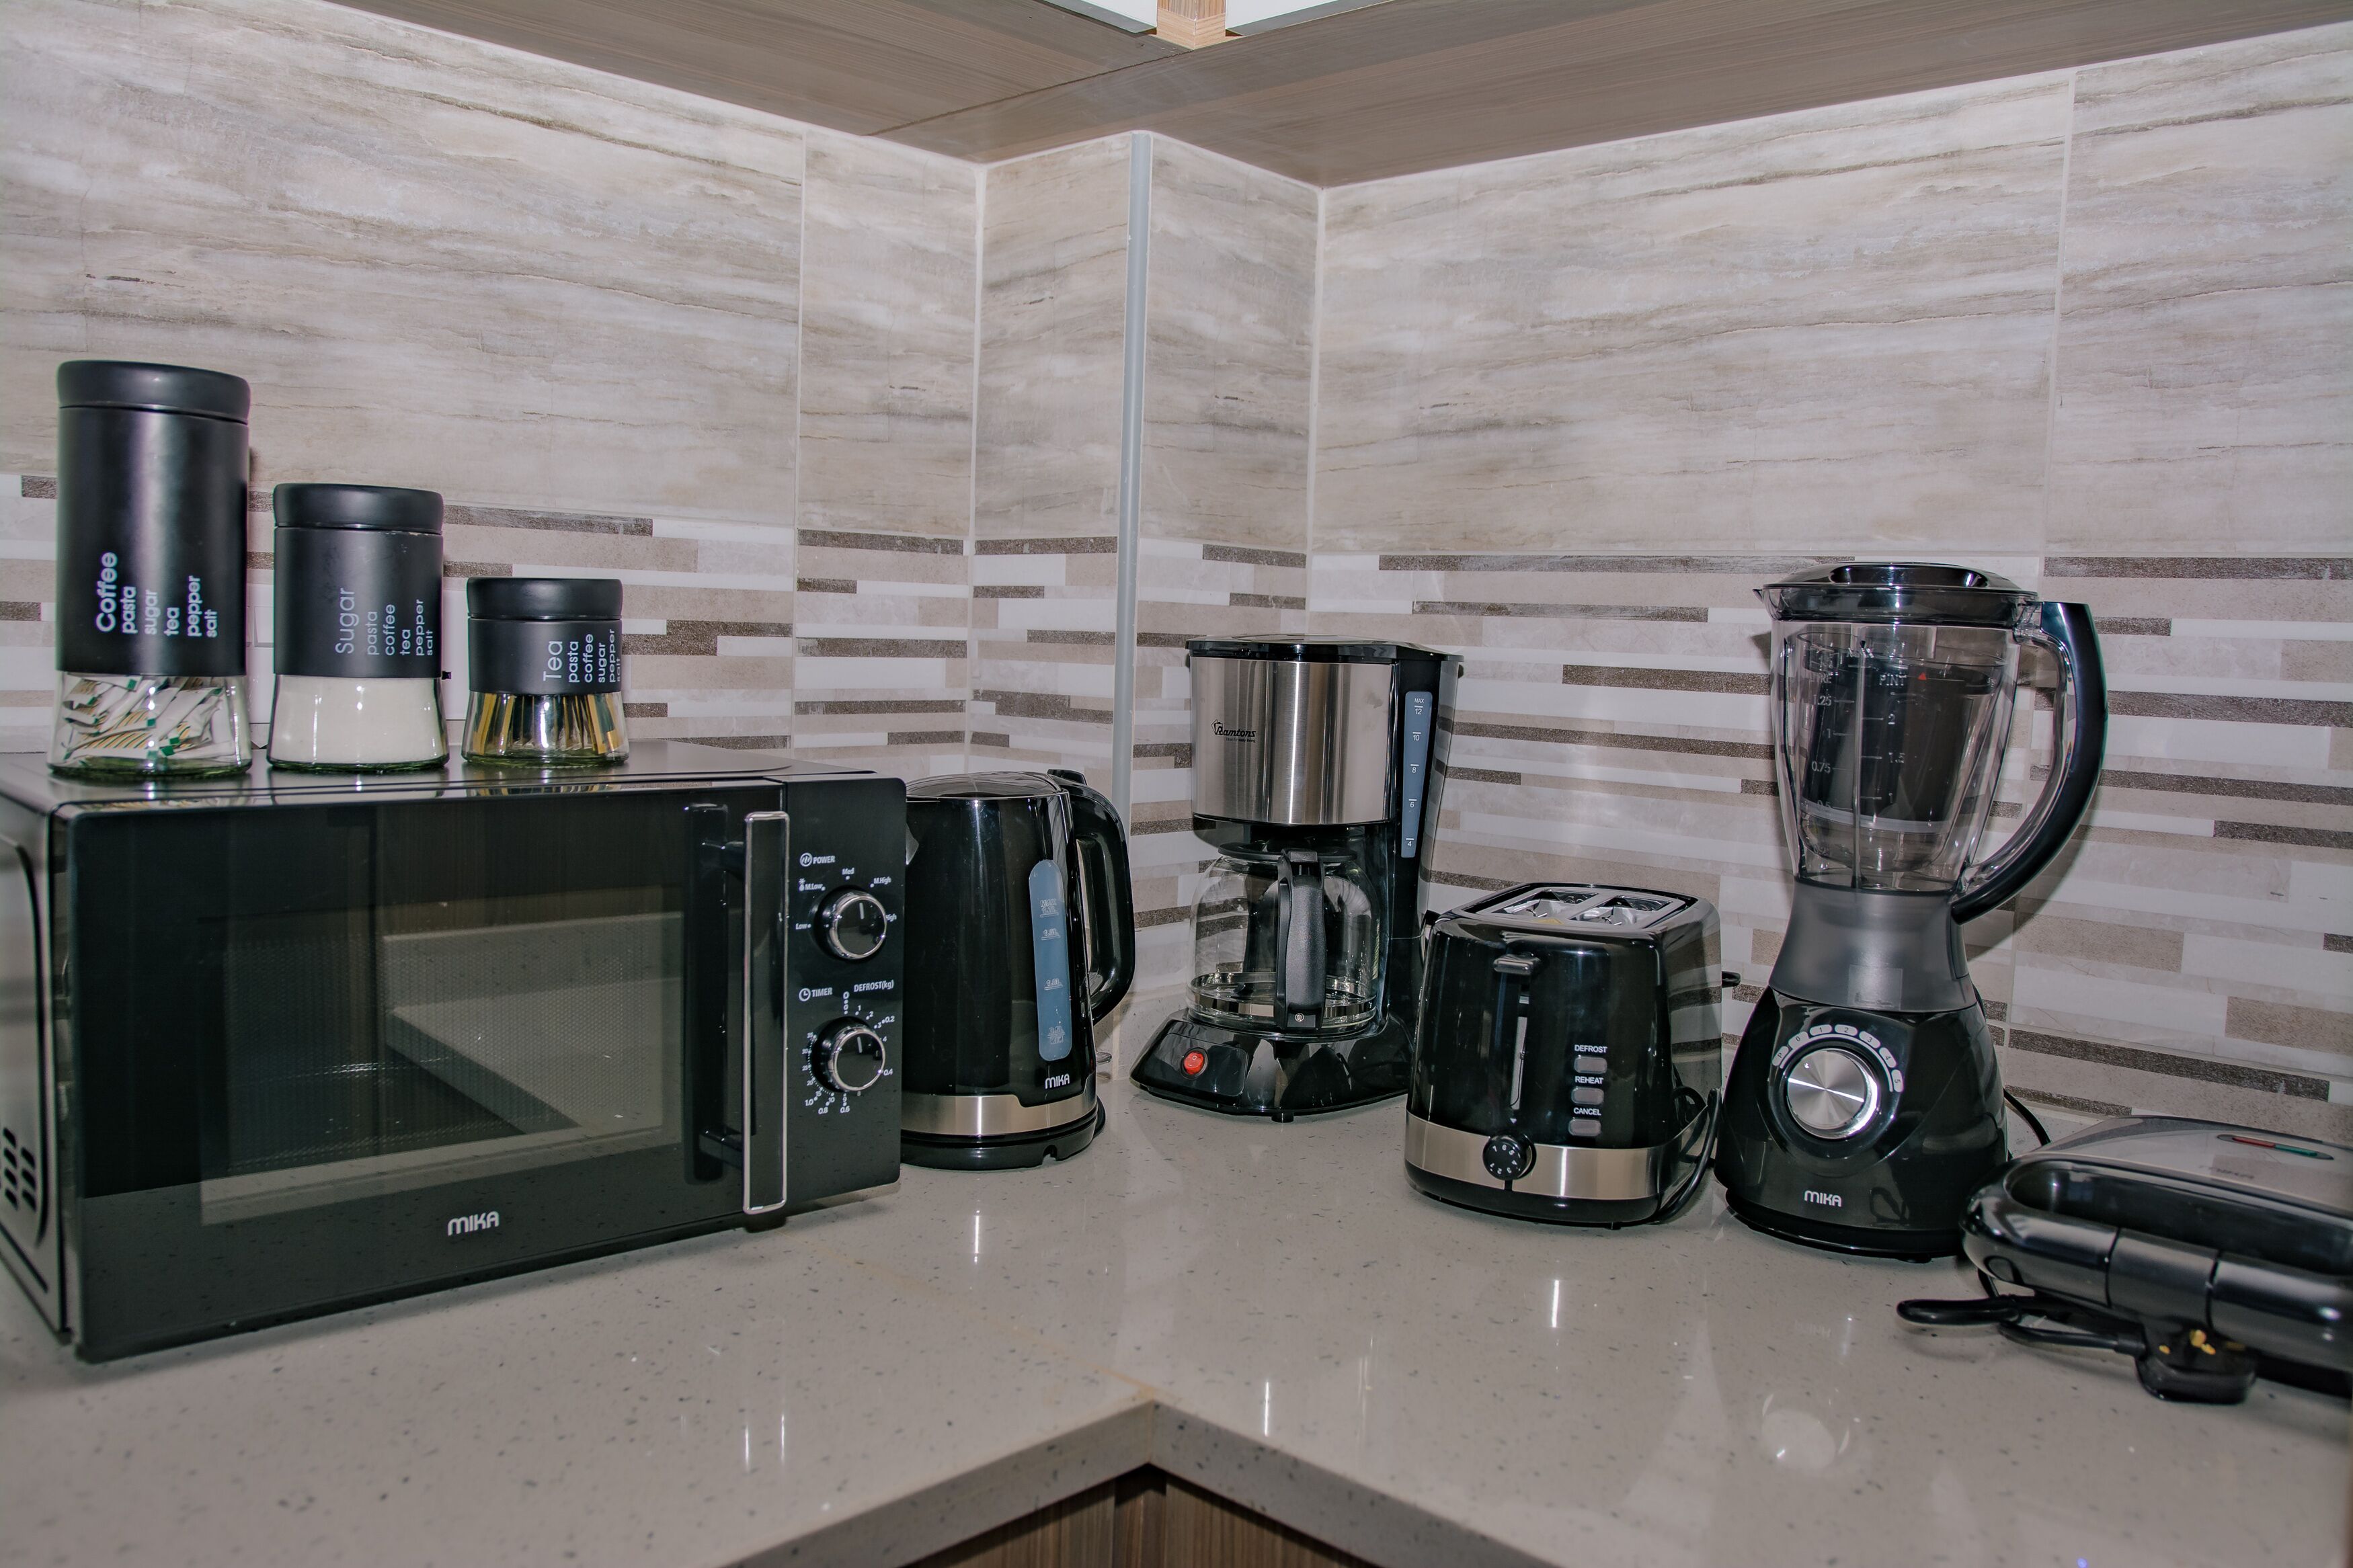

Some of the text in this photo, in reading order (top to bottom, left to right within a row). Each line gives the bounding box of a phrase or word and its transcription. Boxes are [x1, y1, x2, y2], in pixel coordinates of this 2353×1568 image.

[95, 552, 118, 632] Coffee
[120, 586, 138, 634] pasta
[145, 589, 161, 635] sugar
[187, 575, 203, 636] pepper
[164, 607, 180, 636] tea
[204, 609, 217, 638] salt
[335, 588, 360, 654] Sugar
[365, 611, 379, 655] pasta
[383, 604, 395, 656] coffee
[415, 600, 425, 656] pepper
[400, 629, 411, 655] tea
[543, 641, 563, 681] Tea
[567, 641, 580, 683] pasta
[584, 634, 594, 683] coffee
[598, 643, 607, 683] sugar
[1879, 673, 1907, 686] PINT
[1215, 726, 1257, 737] Ramtons
[1888, 714, 1896, 725] 2
[1811, 760, 1831, 774] 0.75
[813, 856, 836, 864] POWER
[873, 876, 891, 885] M.High
[811, 987, 833, 998] TIMER
[885, 1015, 895, 1023] 0.2
[1574, 1044, 1607, 1053] DEFROST
[1045, 1073, 1070, 1089] MIKA
[1574, 1076, 1604, 1084] REHEAT
[818, 1106, 829, 1114] 0.8
[1573, 1108, 1601, 1116] CANCEL
[1804, 1190, 1842, 1207] MIKA
[447, 1210, 500, 1236] MIKA
